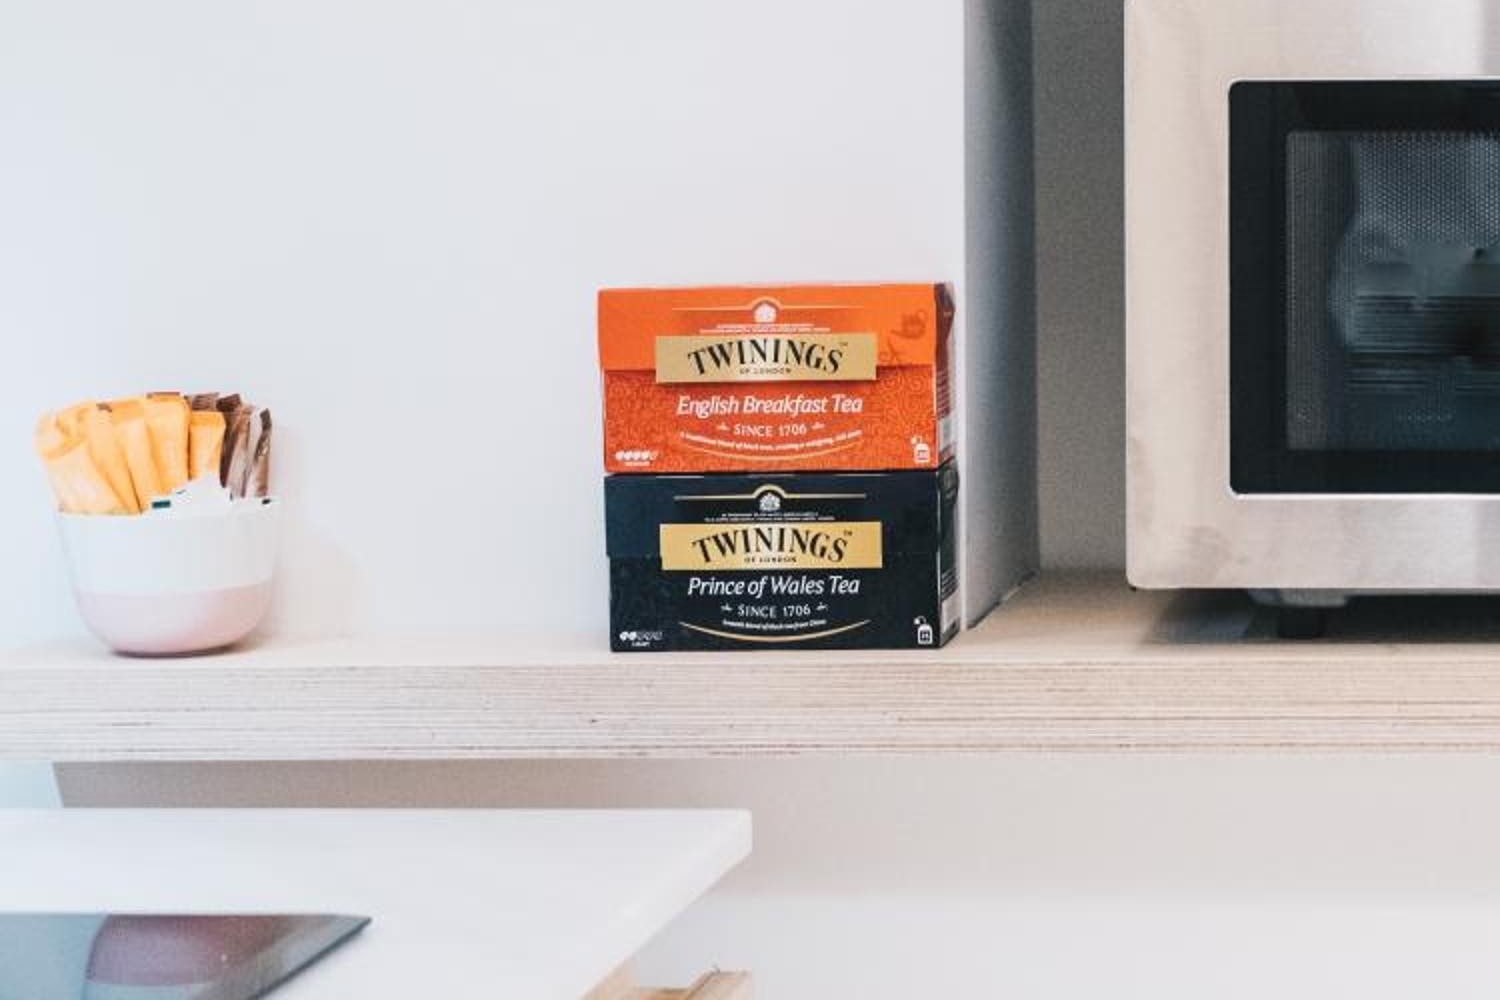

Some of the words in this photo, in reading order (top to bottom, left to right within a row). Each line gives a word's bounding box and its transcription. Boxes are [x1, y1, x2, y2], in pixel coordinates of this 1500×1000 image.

[688, 338, 843, 374] TWININGS
[677, 395, 739, 418] English
[743, 394, 827, 418] Breakfast
[831, 394, 863, 413] Tea
[734, 423, 773, 437] SINCE
[778, 422, 807, 436] 1706
[692, 527, 847, 563] TWININGS
[688, 576, 744, 595] Prince
[747, 575, 770, 598] of
[770, 576, 825, 595] Wales
[829, 576, 860, 594] Tea
[738, 603, 777, 618] SINCE
[783, 603, 811, 617] 1706
